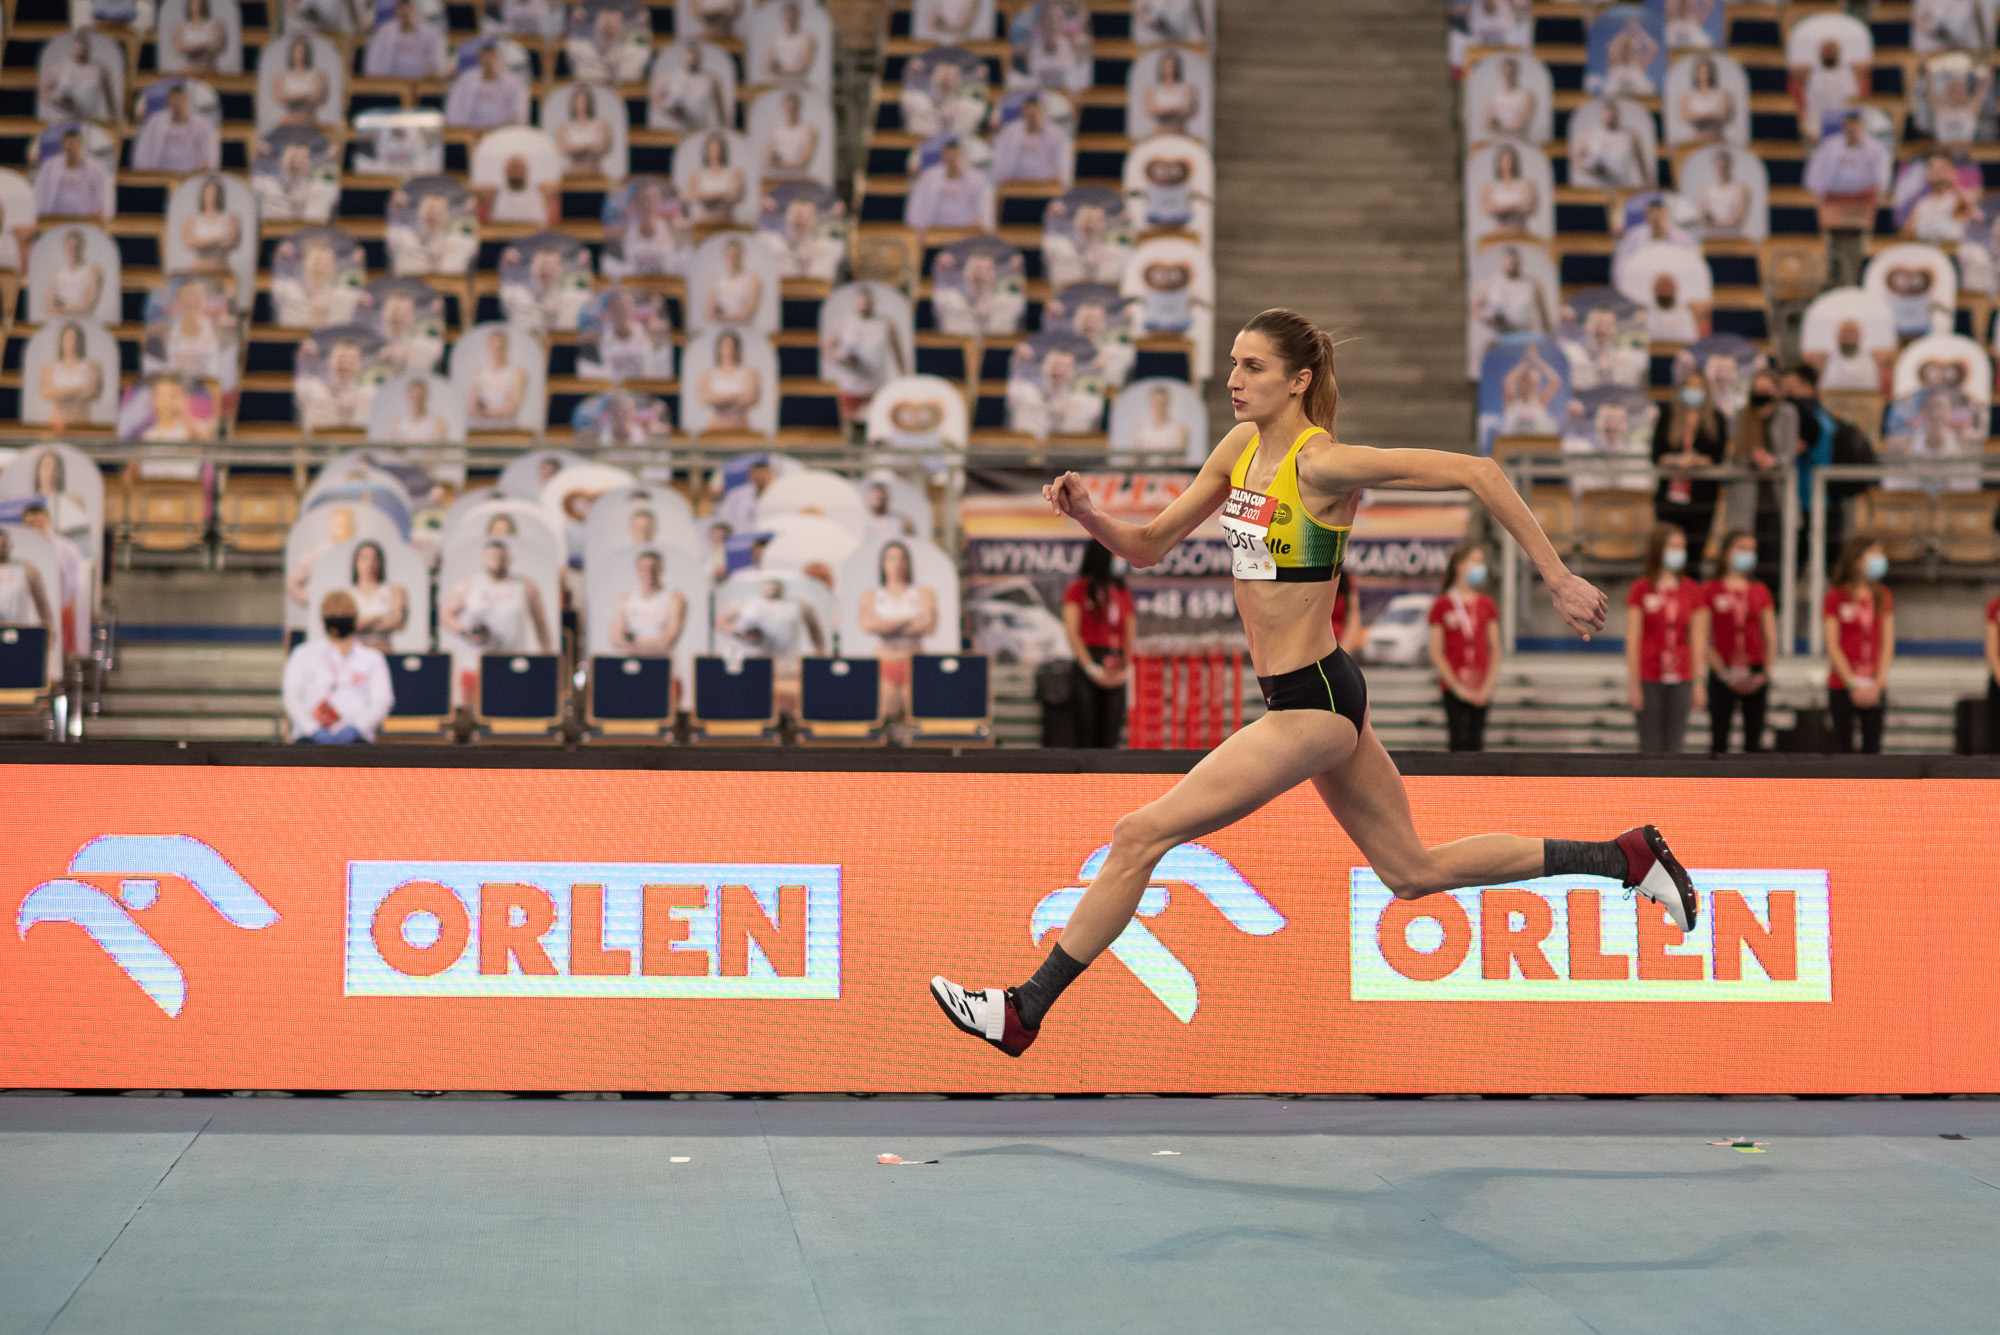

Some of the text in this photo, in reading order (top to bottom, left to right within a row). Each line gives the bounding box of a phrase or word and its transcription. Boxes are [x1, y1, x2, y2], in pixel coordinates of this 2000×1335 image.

[1242, 506, 1261, 521] 2021
[1251, 494, 1267, 508] CUP
[370, 878, 807, 977] ORLEN
[1377, 888, 1798, 981] ORLEN
